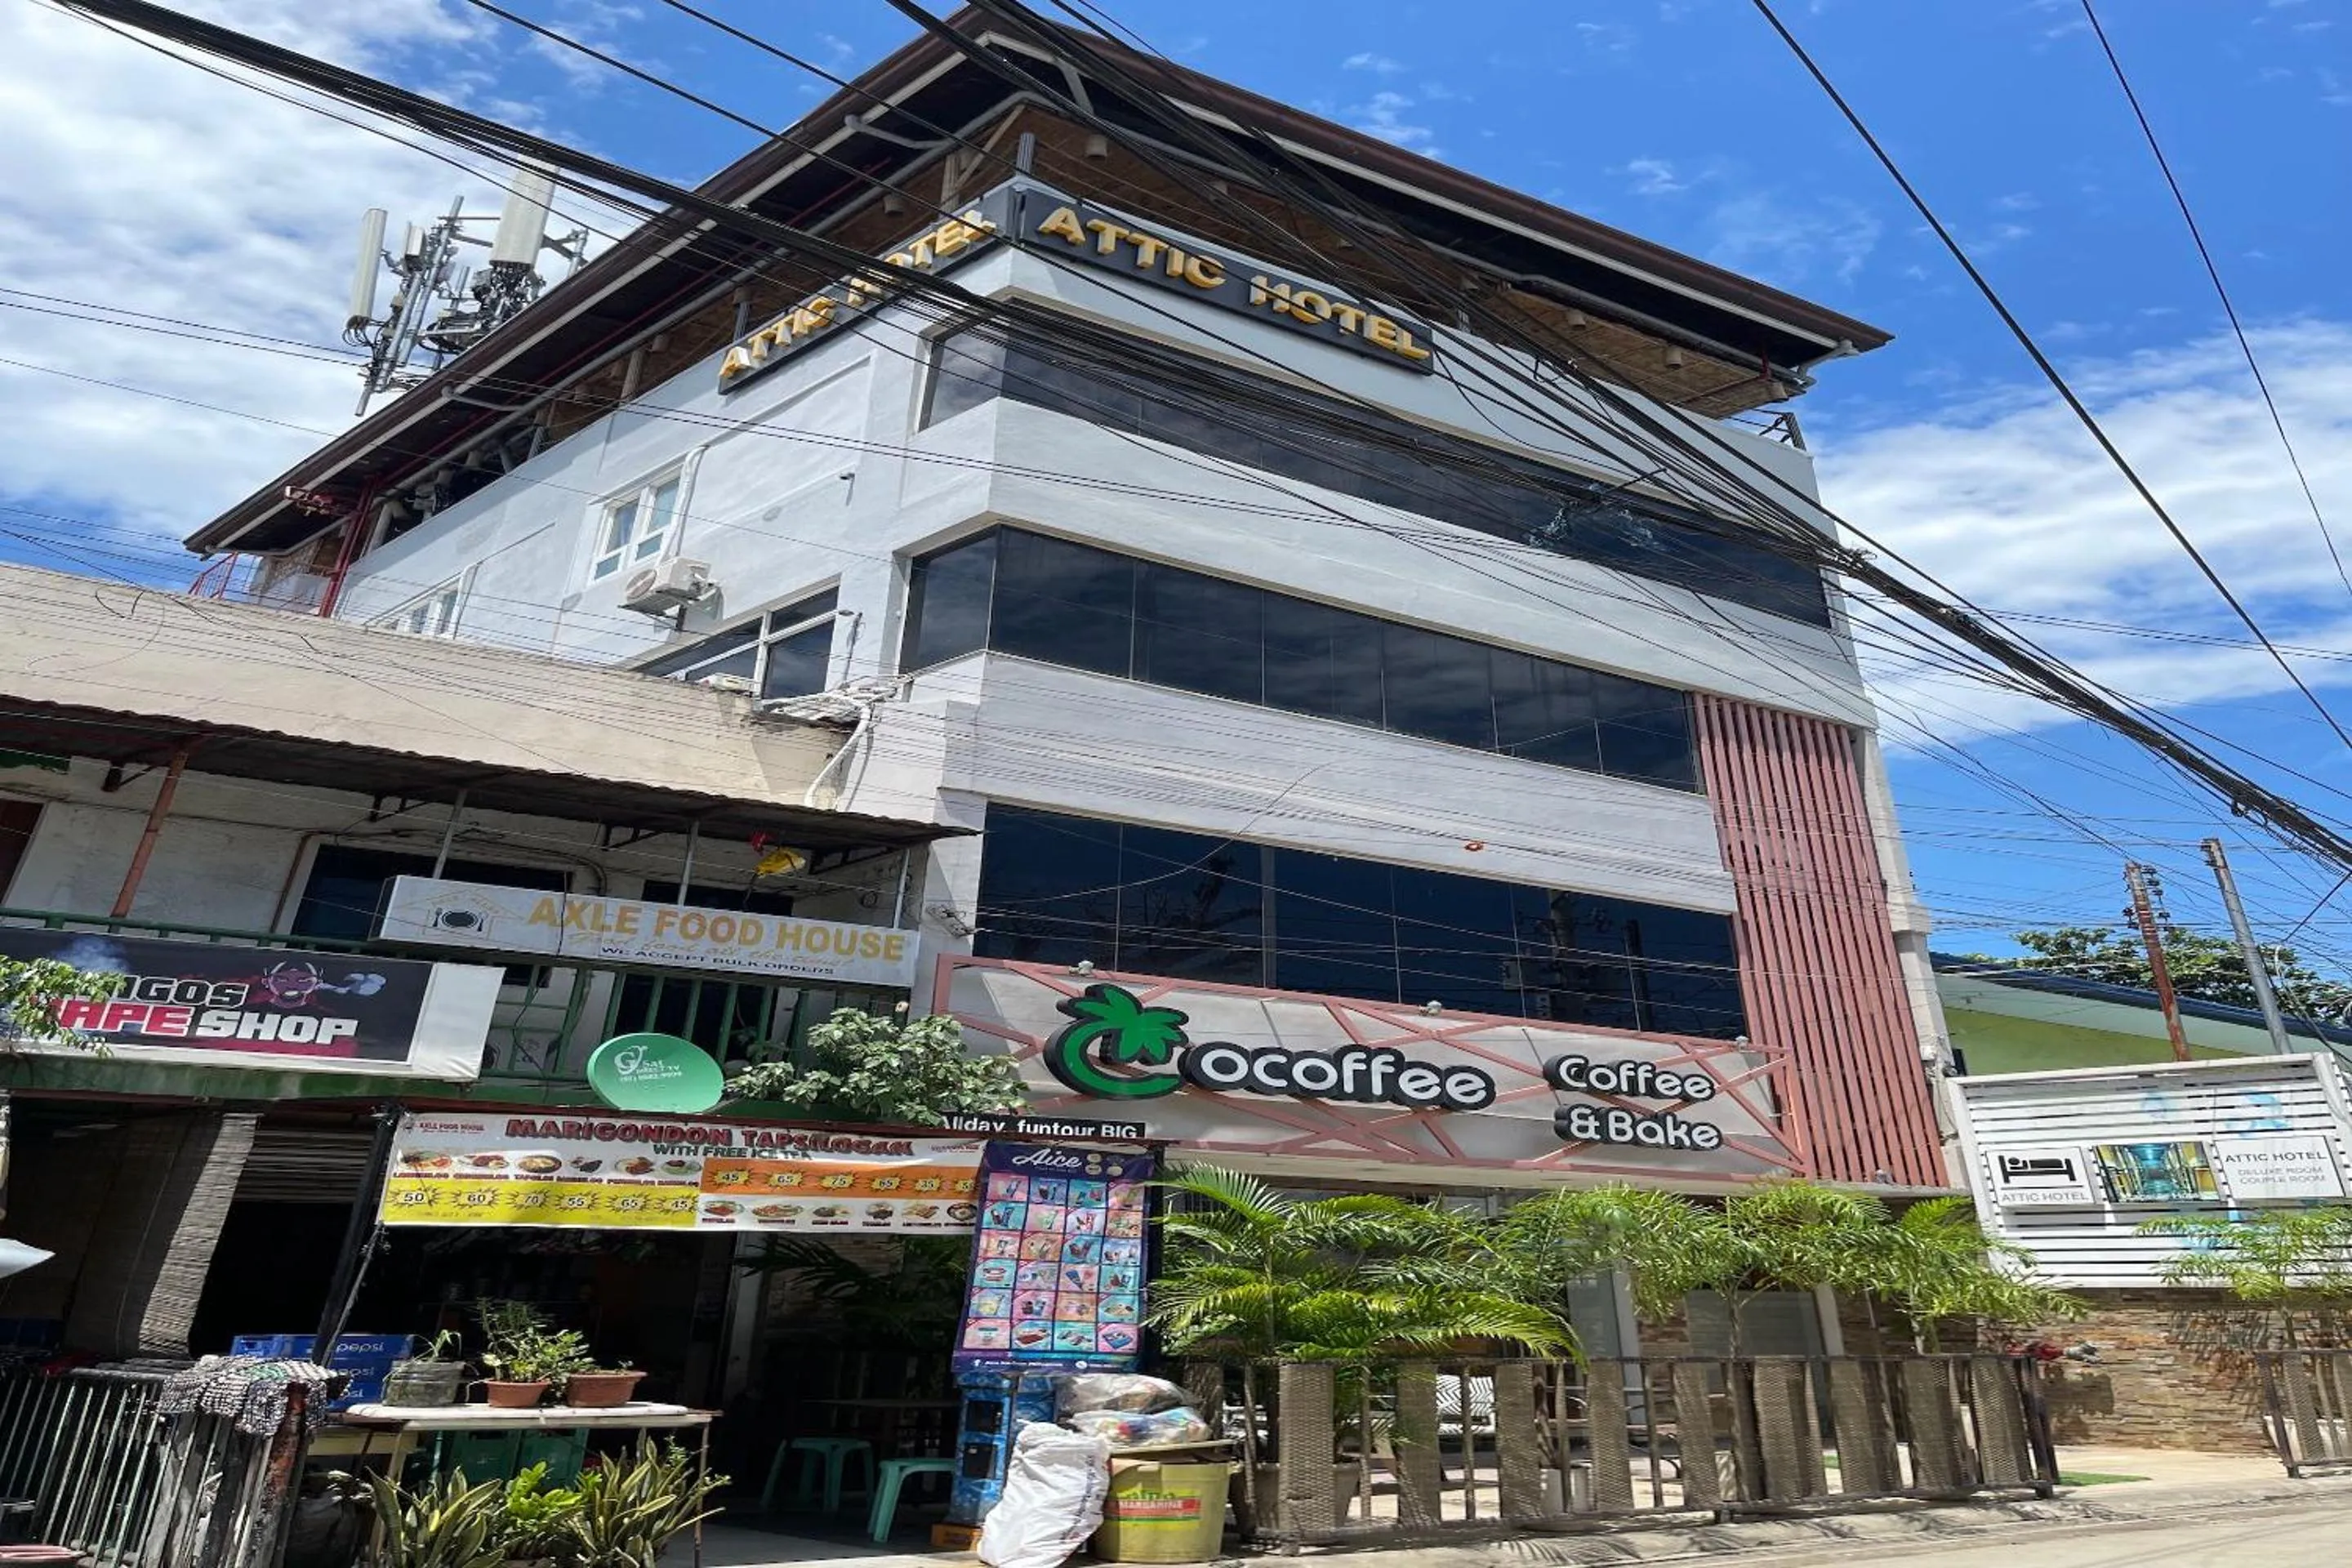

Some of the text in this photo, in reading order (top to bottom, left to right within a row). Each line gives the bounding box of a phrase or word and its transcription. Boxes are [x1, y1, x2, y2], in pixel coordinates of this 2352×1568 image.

[1038, 207, 1430, 360] ATTIC HOTEL
[719, 296, 836, 379] ATTIC
[528, 896, 643, 936] AXLE
[654, 908, 764, 947] FOOD
[775, 921, 906, 961] HOUSE
[601, 947, 835, 974] WE ACCEPT BULK ORDERS
[58, 998, 359, 1045] APE SHOP
[1559, 1057, 1712, 1100] Coffee
[505, 1119, 733, 1147] MARIGONDON
[1018, 1120, 1095, 1137] funtour
[1102, 1126, 1138, 1138] BIG
[1570, 1107, 1720, 1148] & Bake
[654, 1144, 698, 1156] WITH
[702, 1146, 747, 1157] FREE
[1012, 1148, 1083, 1169] Aice
[2225, 1151, 2328, 1163] ATTIC HOTEL
[722, 1173, 739, 1182] 45
[777, 1175, 794, 1184] 65
[404, 1192, 425, 1202] 50
[467, 1193, 487, 1204] 60
[2002, 1192, 2089, 1201] ATTIC HOTEL
[336, 1342, 385, 1353] pepsi
[337, 1367, 375, 1378] epsi
